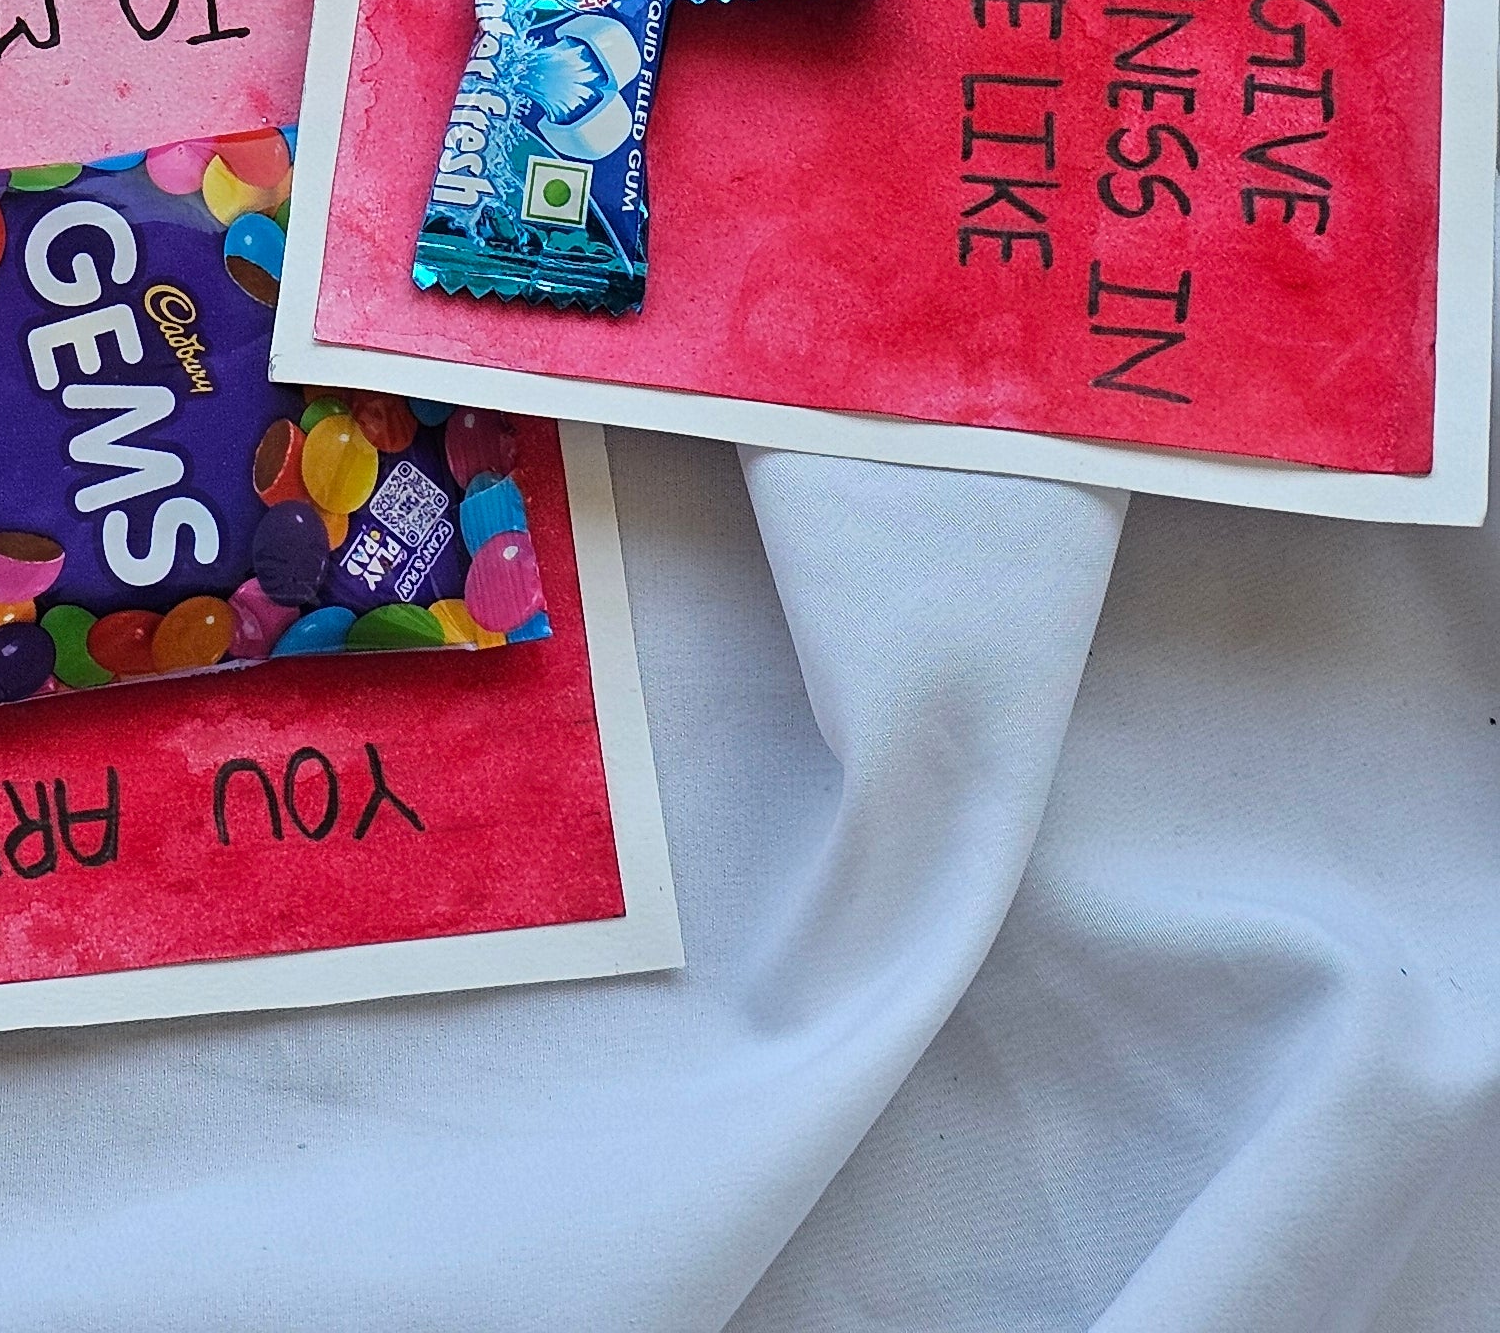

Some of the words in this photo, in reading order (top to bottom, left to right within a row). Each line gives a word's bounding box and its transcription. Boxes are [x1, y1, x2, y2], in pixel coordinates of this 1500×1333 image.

[432, 89, 508, 206] fresh
[632, 69, 652, 140] FILLED
[622, 149, 642, 211] GUM
[959, 74, 1063, 269] LIKE
[144, 285, 214, 393] Cadbury
[1087, 261, 1192, 405] IN
[25, 200, 220, 587] GEMS
[346, 534, 380, 576] PAD
[367, 536, 401, 591] PLAY
[400, 571, 420, 597] PLAY
[214, 742, 425, 846] YOU
